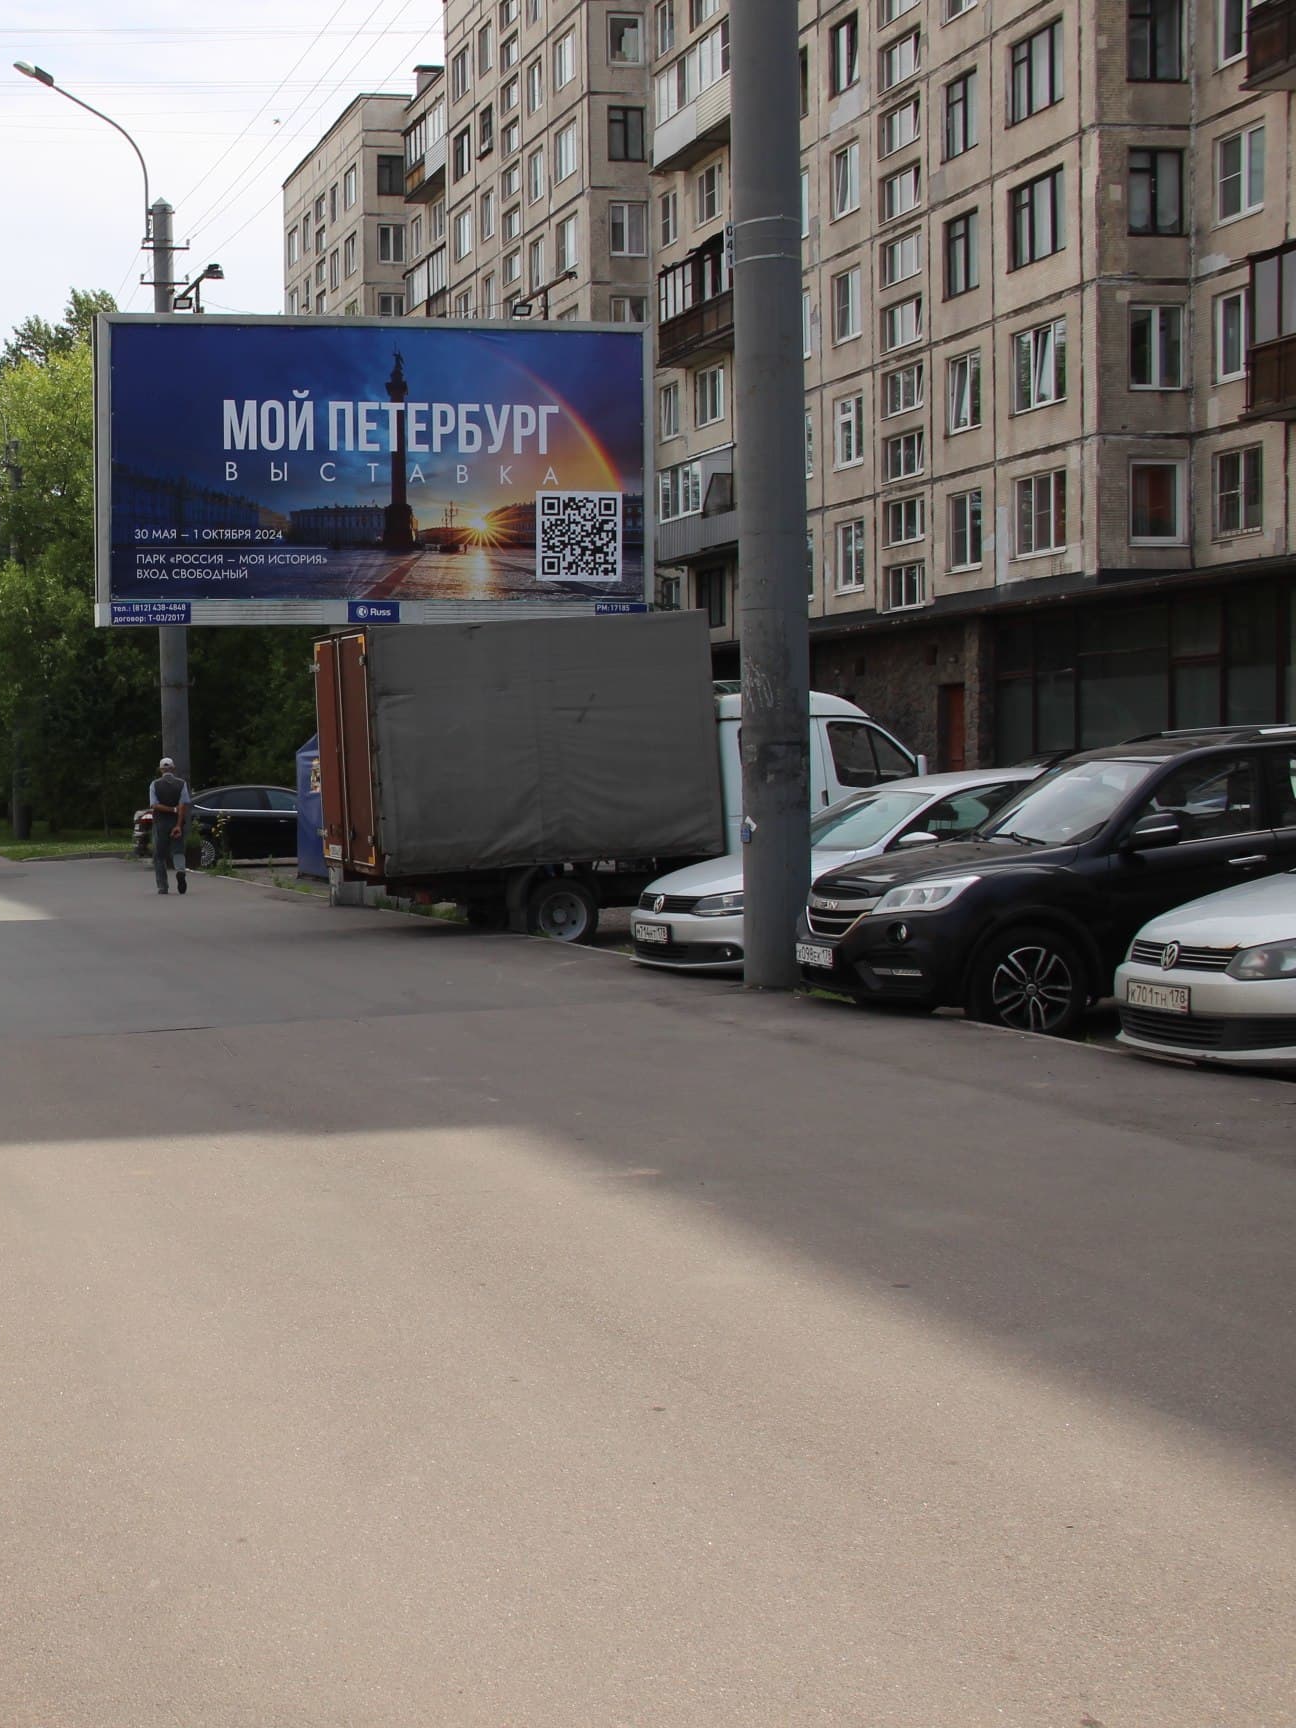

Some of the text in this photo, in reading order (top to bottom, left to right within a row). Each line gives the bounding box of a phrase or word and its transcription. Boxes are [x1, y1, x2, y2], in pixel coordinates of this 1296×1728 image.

[223, 389, 559, 455] МОЙ ПЕТЕРБУРГ
[225, 461, 559, 485] ВЫСТАВКА
[134, 529, 149, 540] 30
[152, 529, 177, 540] МАЯ
[202, 529, 251, 540] ОКТЯБРЯ
[255, 529, 283, 540] 2024
[136, 554, 166, 564] ПАРК
[170, 554, 224, 564] «РОССИЯ
[239, 554, 265, 564] МОЯ
[268, 554, 328, 564] ИСТОРИЯ»
[136, 567, 248, 580] ВХОД СВОБОДНЫЙ
[132, 604, 151, 612] (812)
[369, 608, 392, 616] Russ
